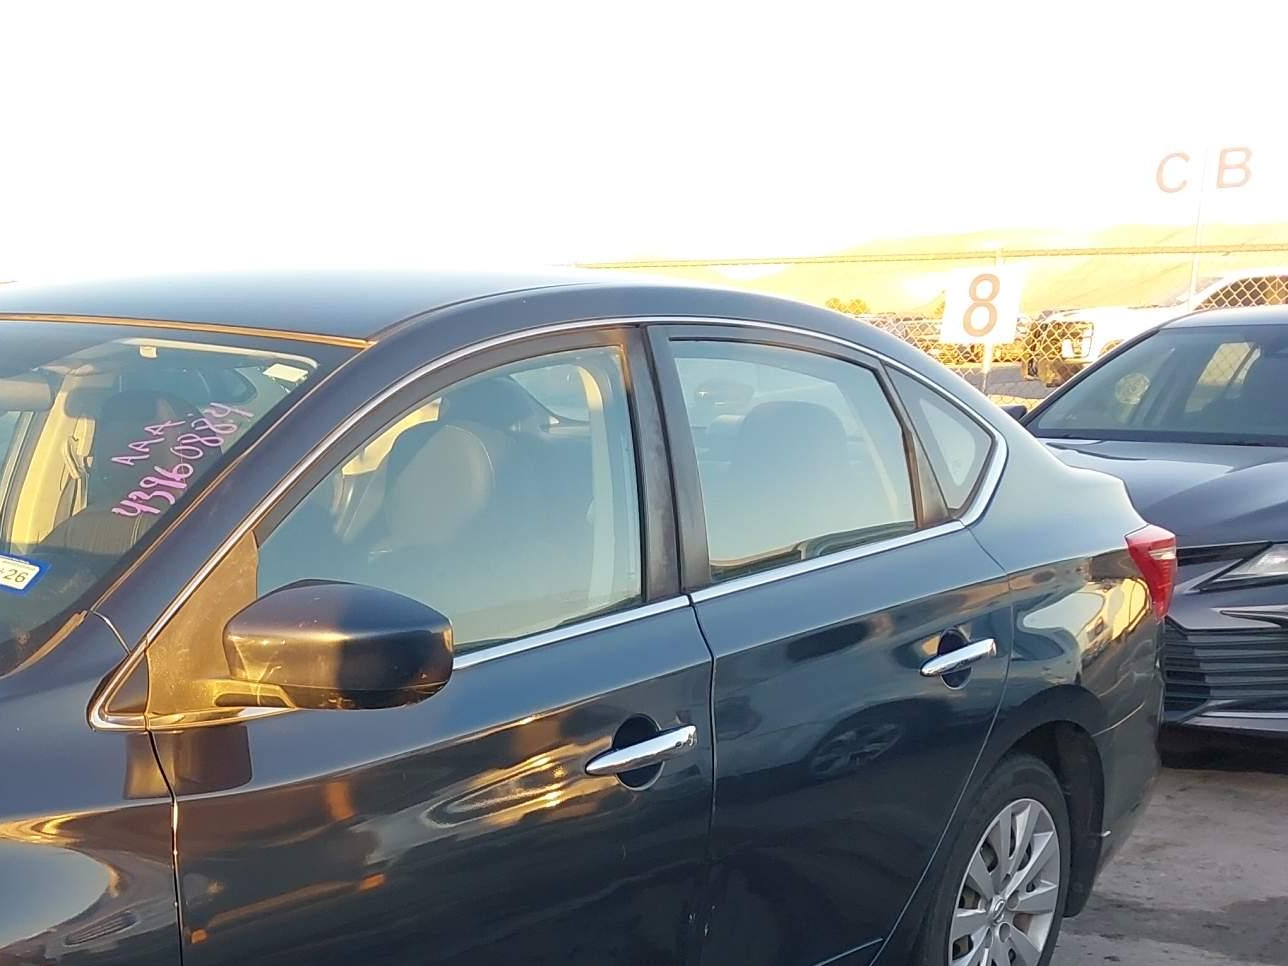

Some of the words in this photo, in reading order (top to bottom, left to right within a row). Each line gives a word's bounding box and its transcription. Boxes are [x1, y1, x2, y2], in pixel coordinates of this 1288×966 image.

[1155, 151, 1191, 194] C
[1215, 146, 1254, 189] B
[962, 272, 1001, 338] 8
[111, 402, 255, 517] 43960884
